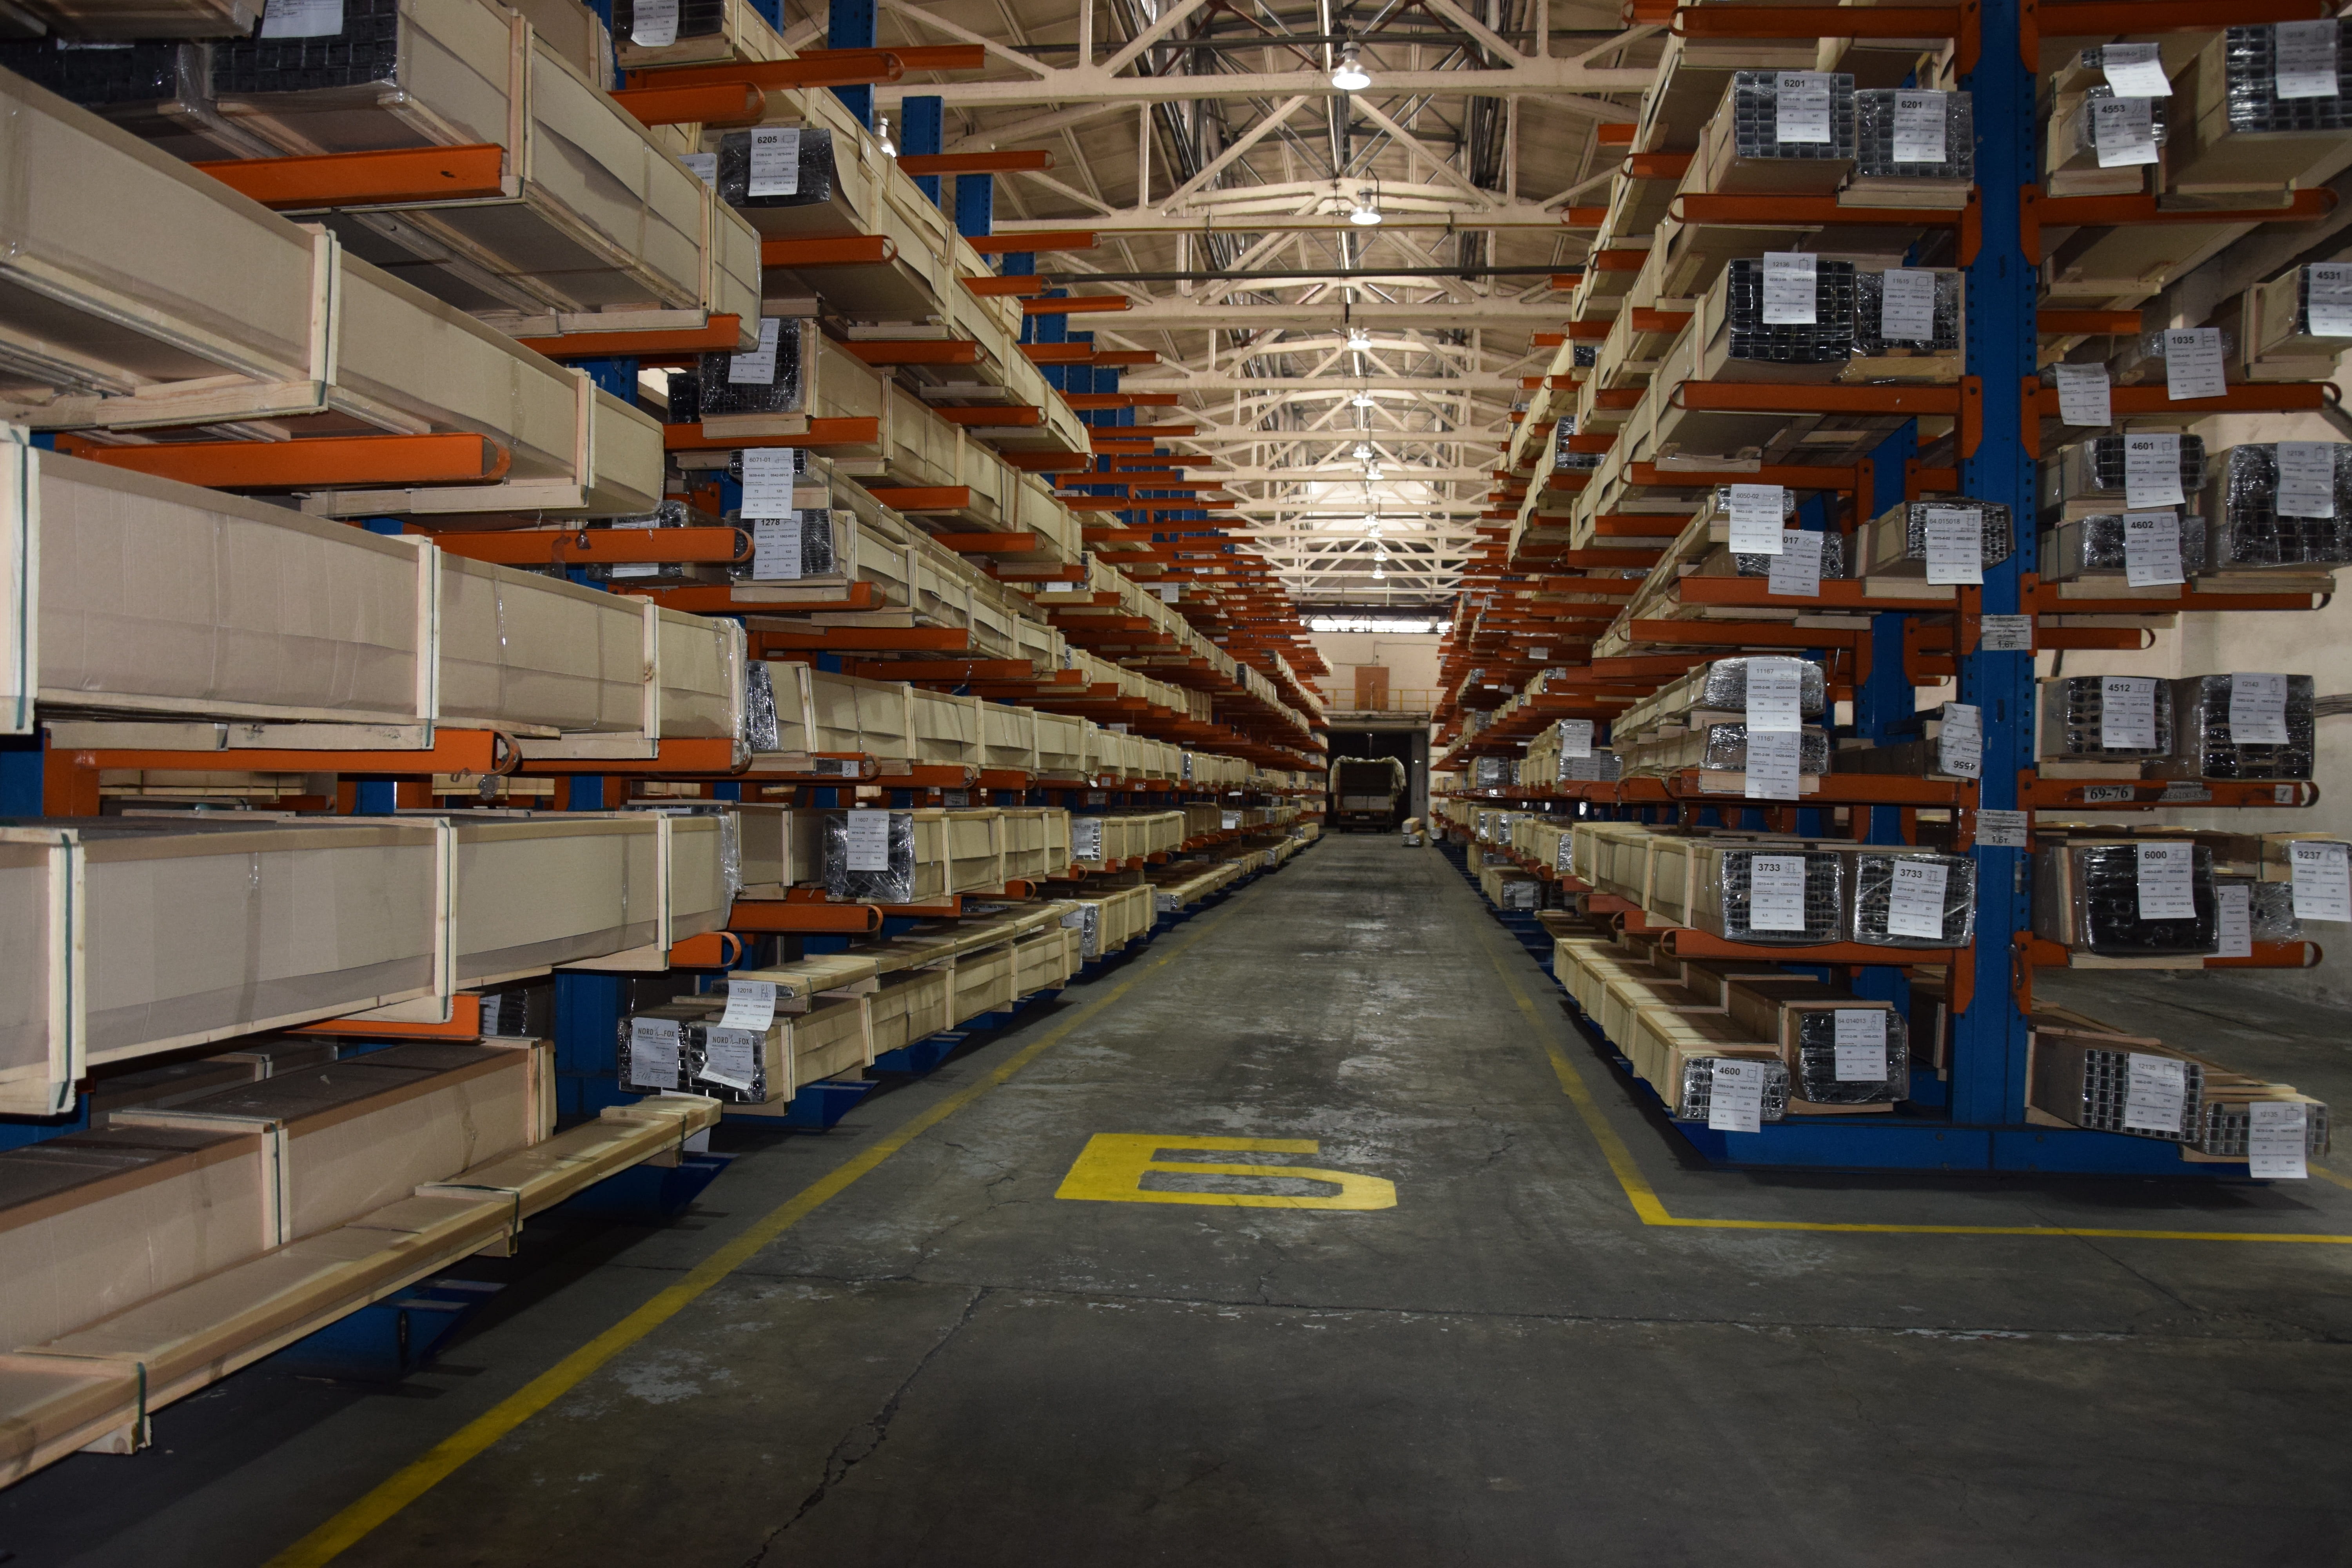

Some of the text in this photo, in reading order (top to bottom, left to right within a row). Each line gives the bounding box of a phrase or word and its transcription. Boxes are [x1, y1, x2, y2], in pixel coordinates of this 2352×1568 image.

[2102, 105, 2125, 113] 4553
[846, 764, 851, 775] 3
[1954, 761, 1975, 770] 4556
[2090, 786, 2129, 800] 69-76
[2298, 851, 2321, 859] 9237
[1900, 869, 1922, 878] 3733
[1719, 1067, 1740, 1075] 4600
